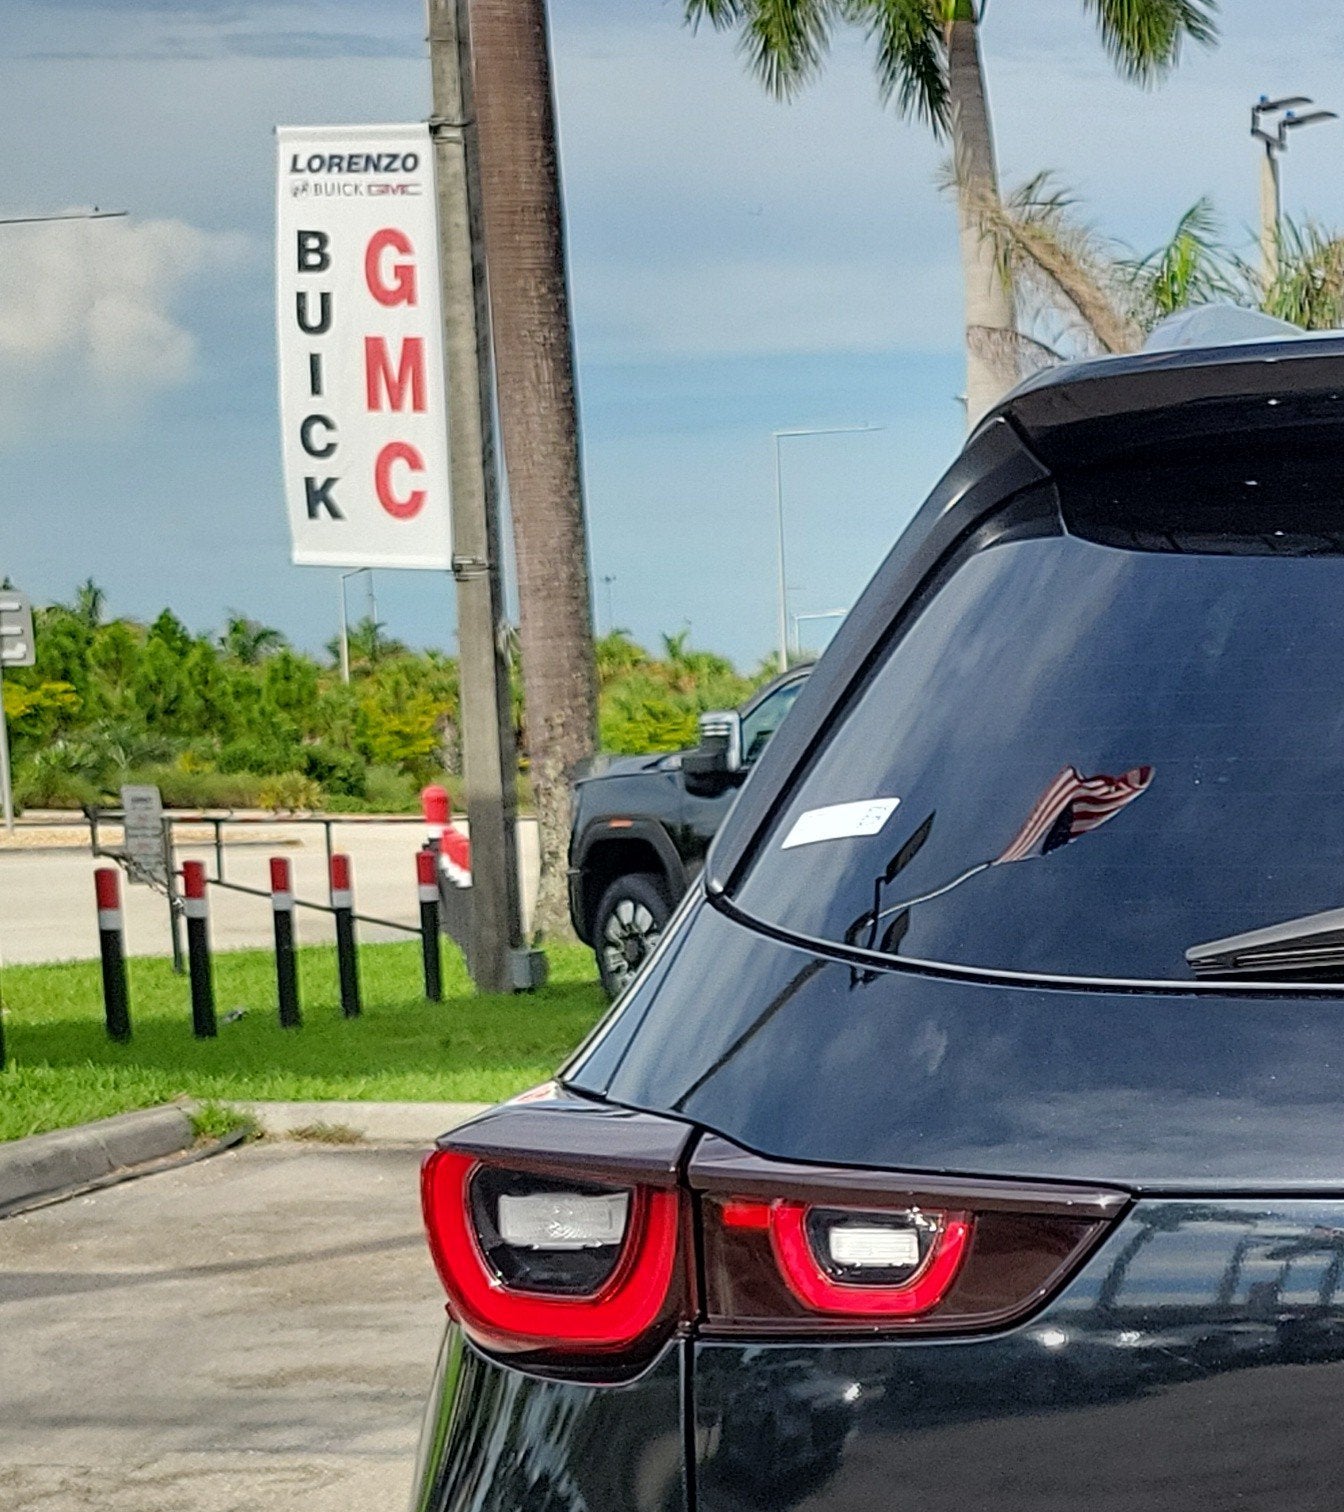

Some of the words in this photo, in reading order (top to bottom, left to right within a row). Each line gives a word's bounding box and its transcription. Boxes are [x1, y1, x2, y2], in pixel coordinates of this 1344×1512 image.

[290, 153, 419, 173] LORENZO
[314, 183, 364, 197] BUICK
[296, 229, 345, 520] BUICK
[364, 228, 427, 520] GMC
